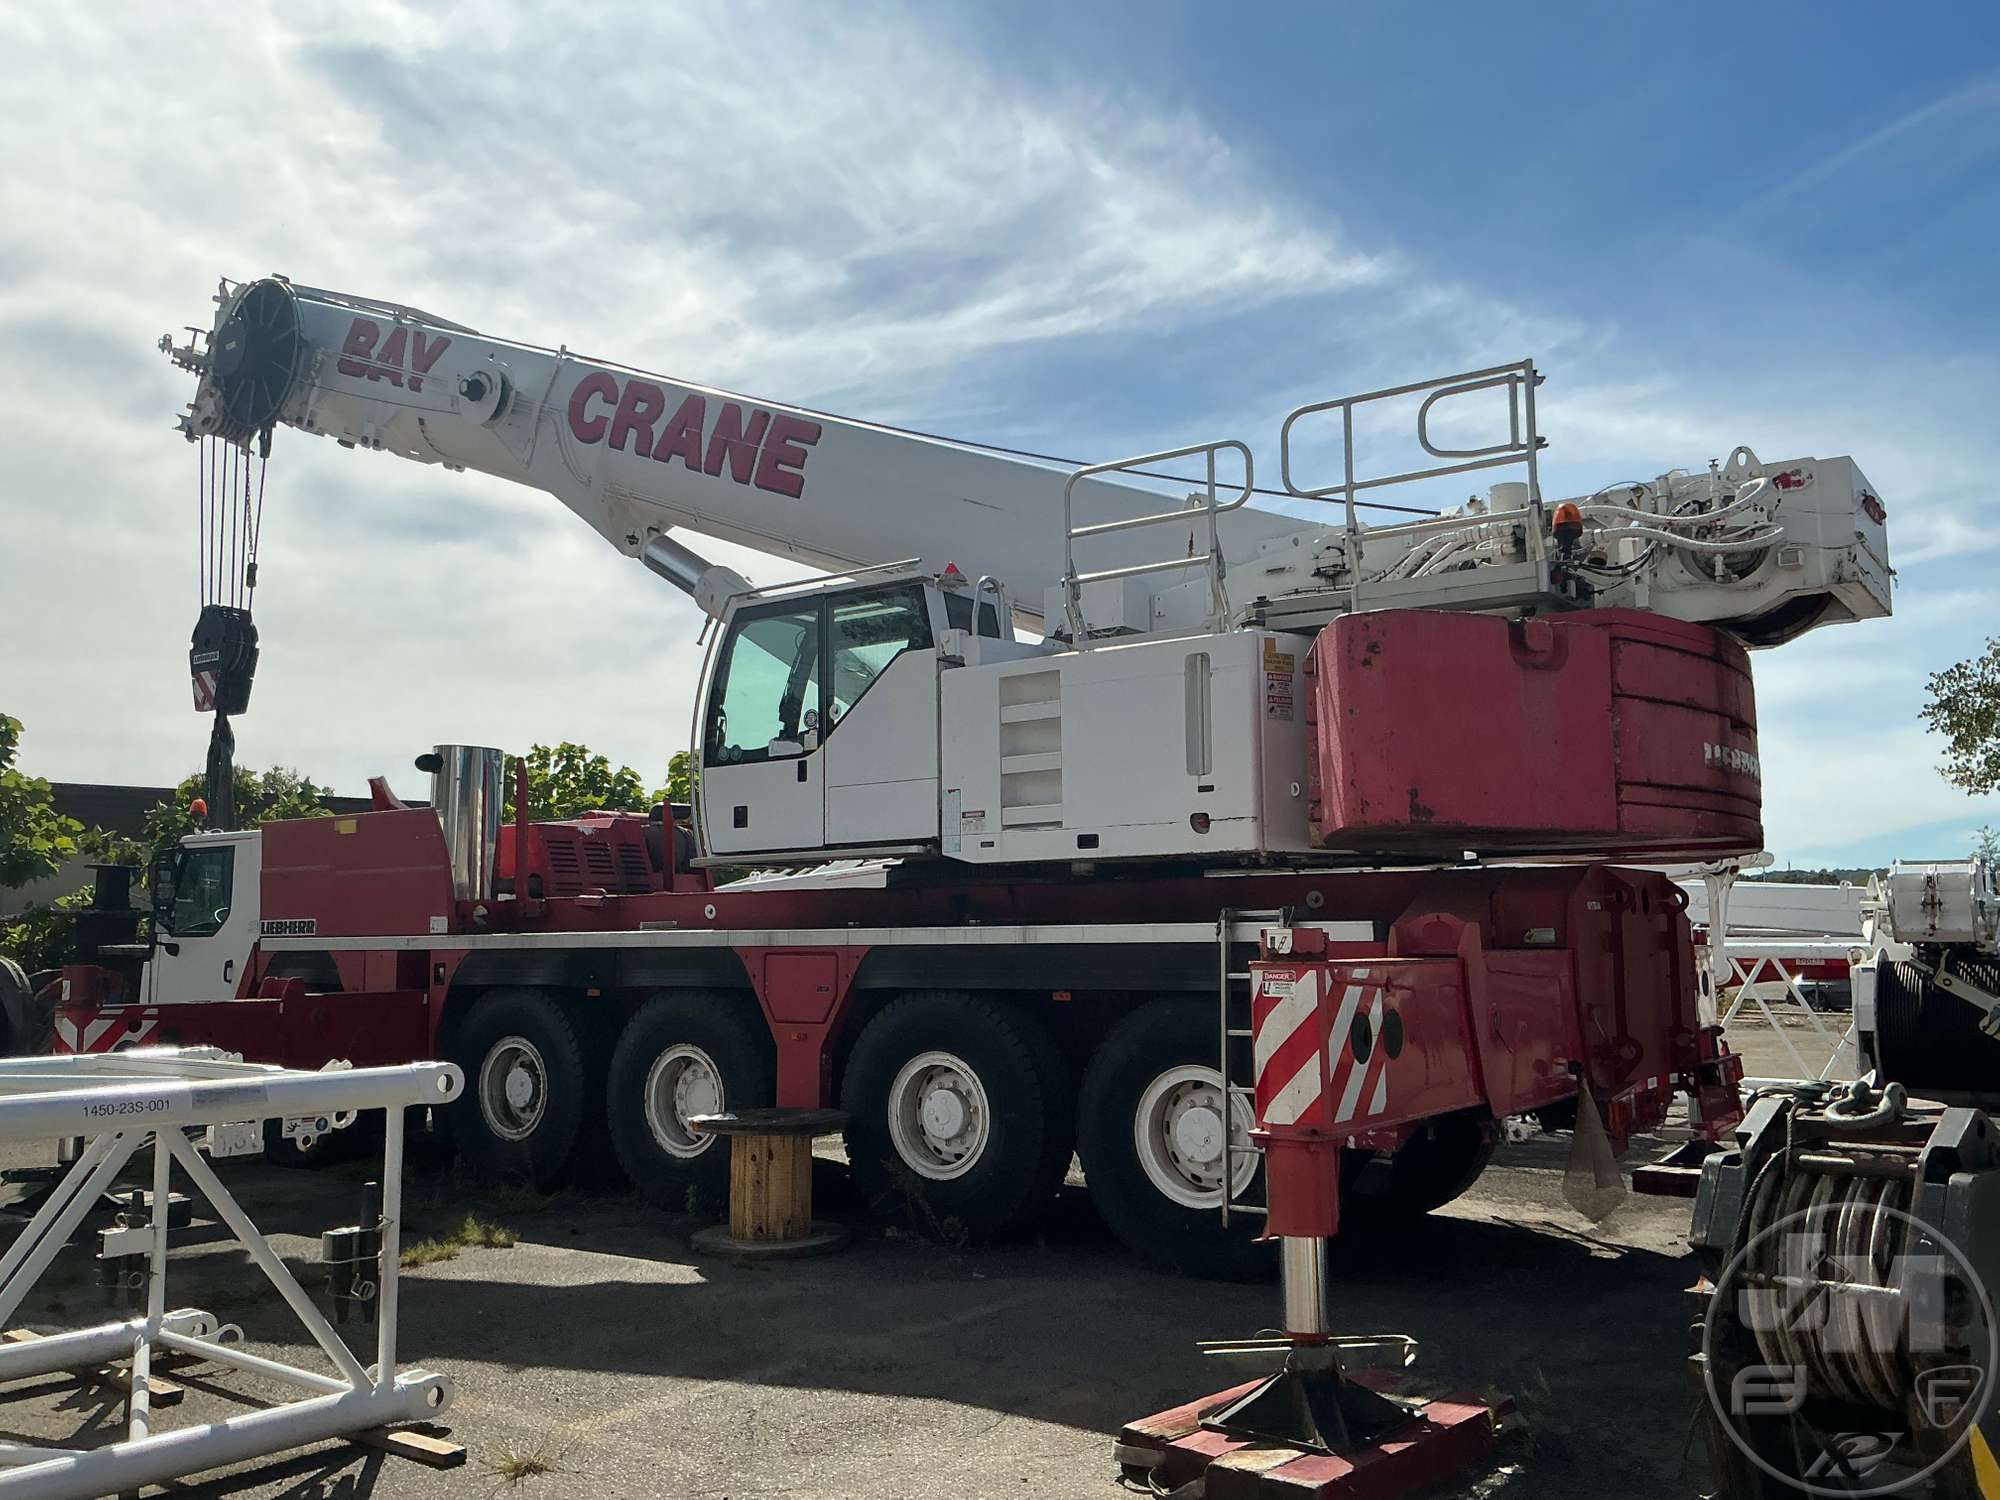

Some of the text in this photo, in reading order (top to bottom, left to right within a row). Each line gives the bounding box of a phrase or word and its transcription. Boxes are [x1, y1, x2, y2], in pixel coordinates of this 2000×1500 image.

[337, 317, 452, 393] BAY
[567, 371, 823, 499] CRANE
[260, 920, 315, 935] LIEBHERR
[83, 1099, 170, 1118] 1450-23S-001
